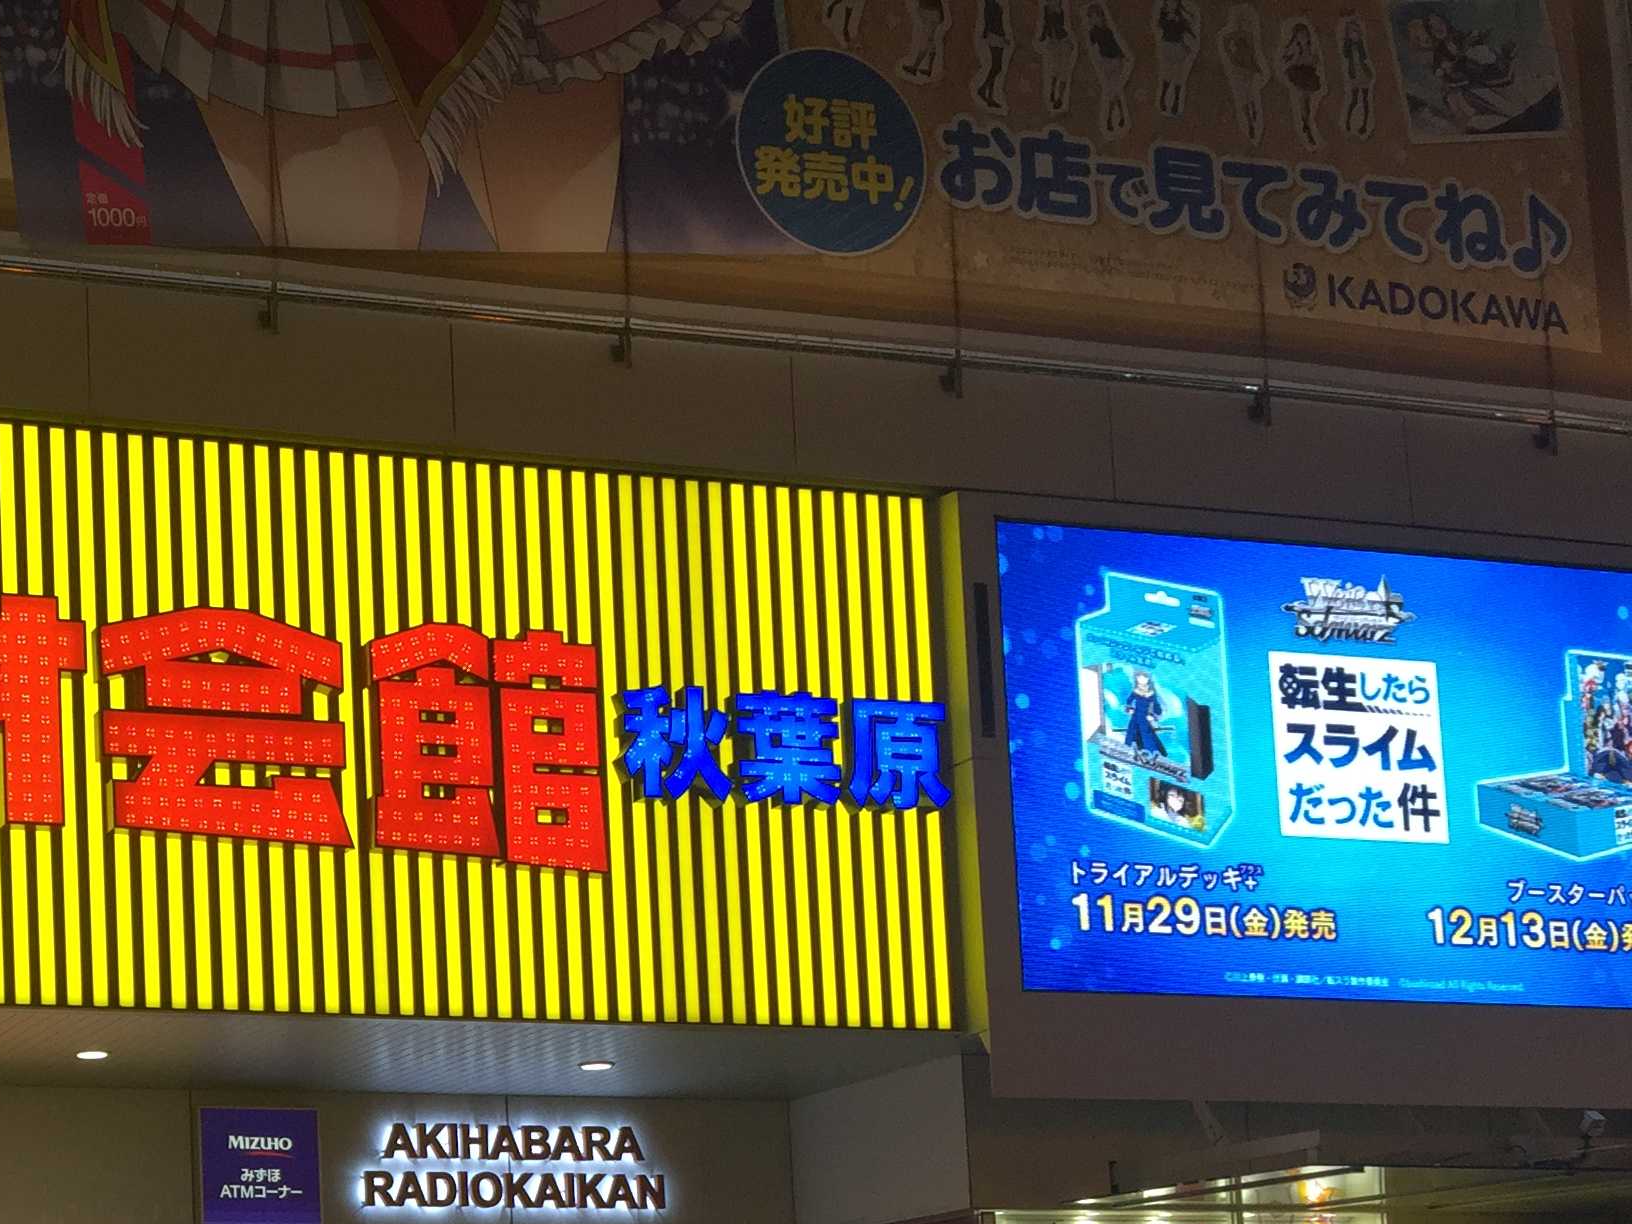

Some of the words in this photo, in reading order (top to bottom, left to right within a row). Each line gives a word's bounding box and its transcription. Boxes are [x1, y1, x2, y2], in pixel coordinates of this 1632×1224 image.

[784, 94, 879, 146] 好評
[1327, 272, 1568, 335] KADOKAWA
[1279, 663, 1432, 713] 転生したら
[1283, 723, 1438, 772] スライム
[1287, 782, 1442, 833] だった件
[1507, 879, 1632, 906] ブースターパ
[1070, 892, 1337, 941] 11月29日(金)発売
[227, 1134, 294, 1152] MIZUHO
[380, 1121, 645, 1162] AKIHABARA
[219, 1183, 303, 1199] ATMコーナー
[239, 1167, 282, 1184] みずほ
[361, 1169, 667, 1210] RADIOKAIKAN
